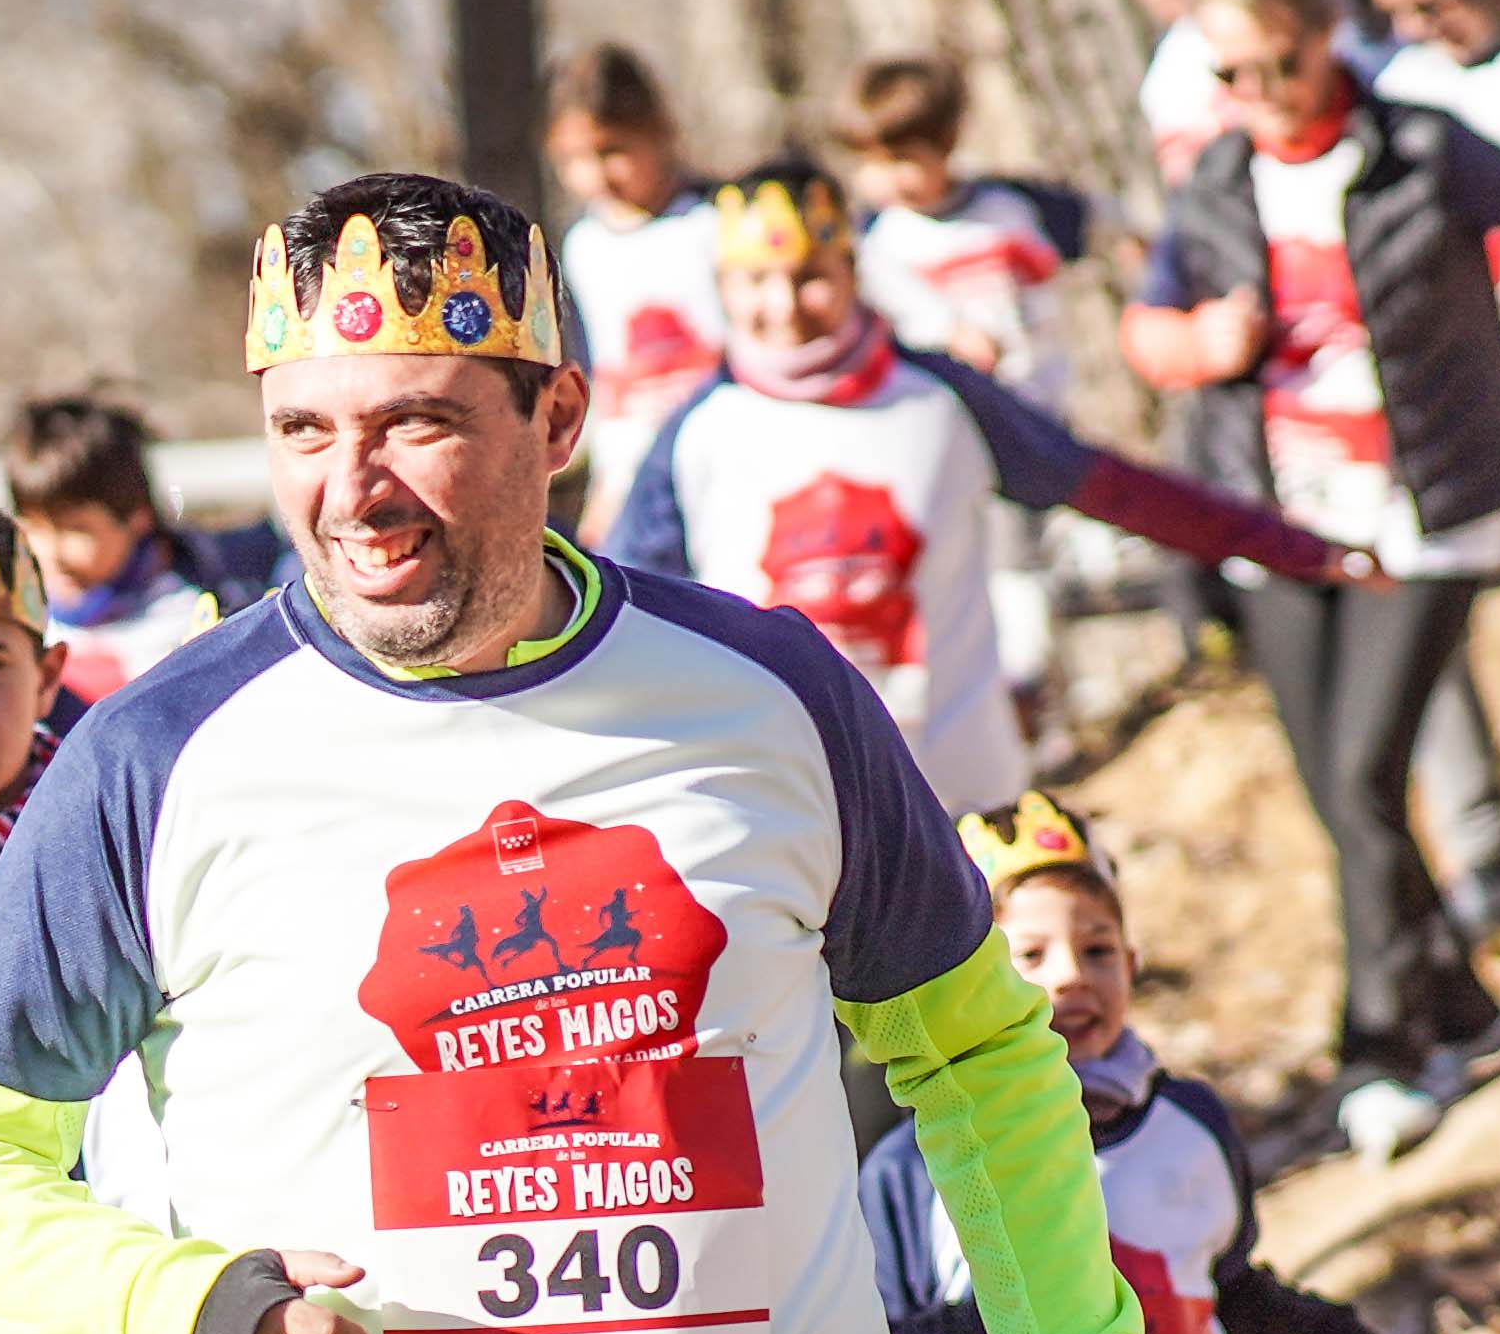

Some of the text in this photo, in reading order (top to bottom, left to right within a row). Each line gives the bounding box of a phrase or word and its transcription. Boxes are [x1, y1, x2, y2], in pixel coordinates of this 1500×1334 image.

[450, 966, 651, 1015] CARRERA POPULAR
[434, 989, 680, 1073] REYES MAGOS
[480, 1132, 660, 1157] CARRERA POPULAR
[446, 1157, 694, 1217] REYES MAGOS
[477, 1224, 680, 1319] 340
